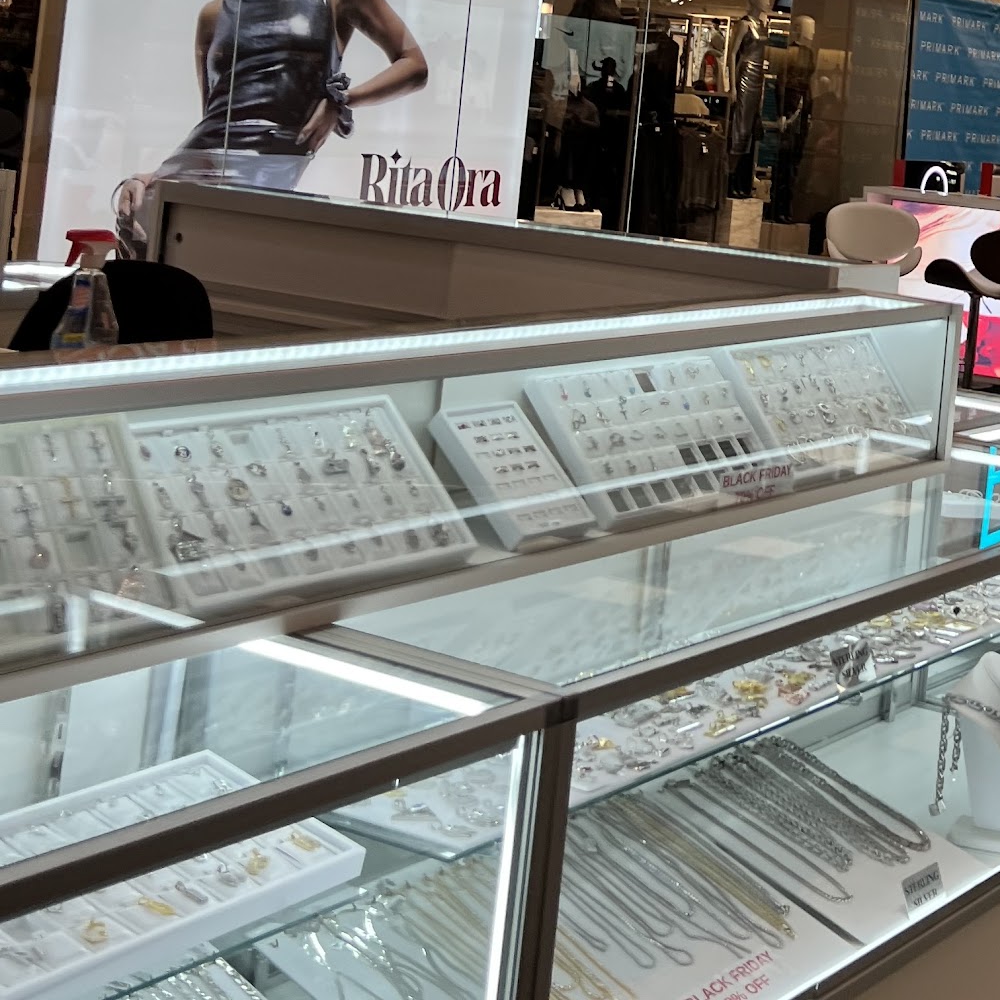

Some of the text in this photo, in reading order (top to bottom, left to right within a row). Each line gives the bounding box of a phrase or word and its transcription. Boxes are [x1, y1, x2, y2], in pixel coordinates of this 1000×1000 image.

[951, 15, 987, 30] PRIMARK
[920, 41, 960, 56] PRIMARK
[967, 47, 1000, 62] PRIMARK
[934, 71, 976, 87] PRIMARK
[949, 102, 989, 117] PRIMARK
[920, 129, 958, 142] PRIMARK
[965, 132, 1000, 145] PRIMARK
[359, 148, 501, 212] Rita Ora
[722, 465, 791, 488] BLACK FRIDAY
[728, 950, 774, 982] FRIDAY
[744, 974, 770, 994] OFF
